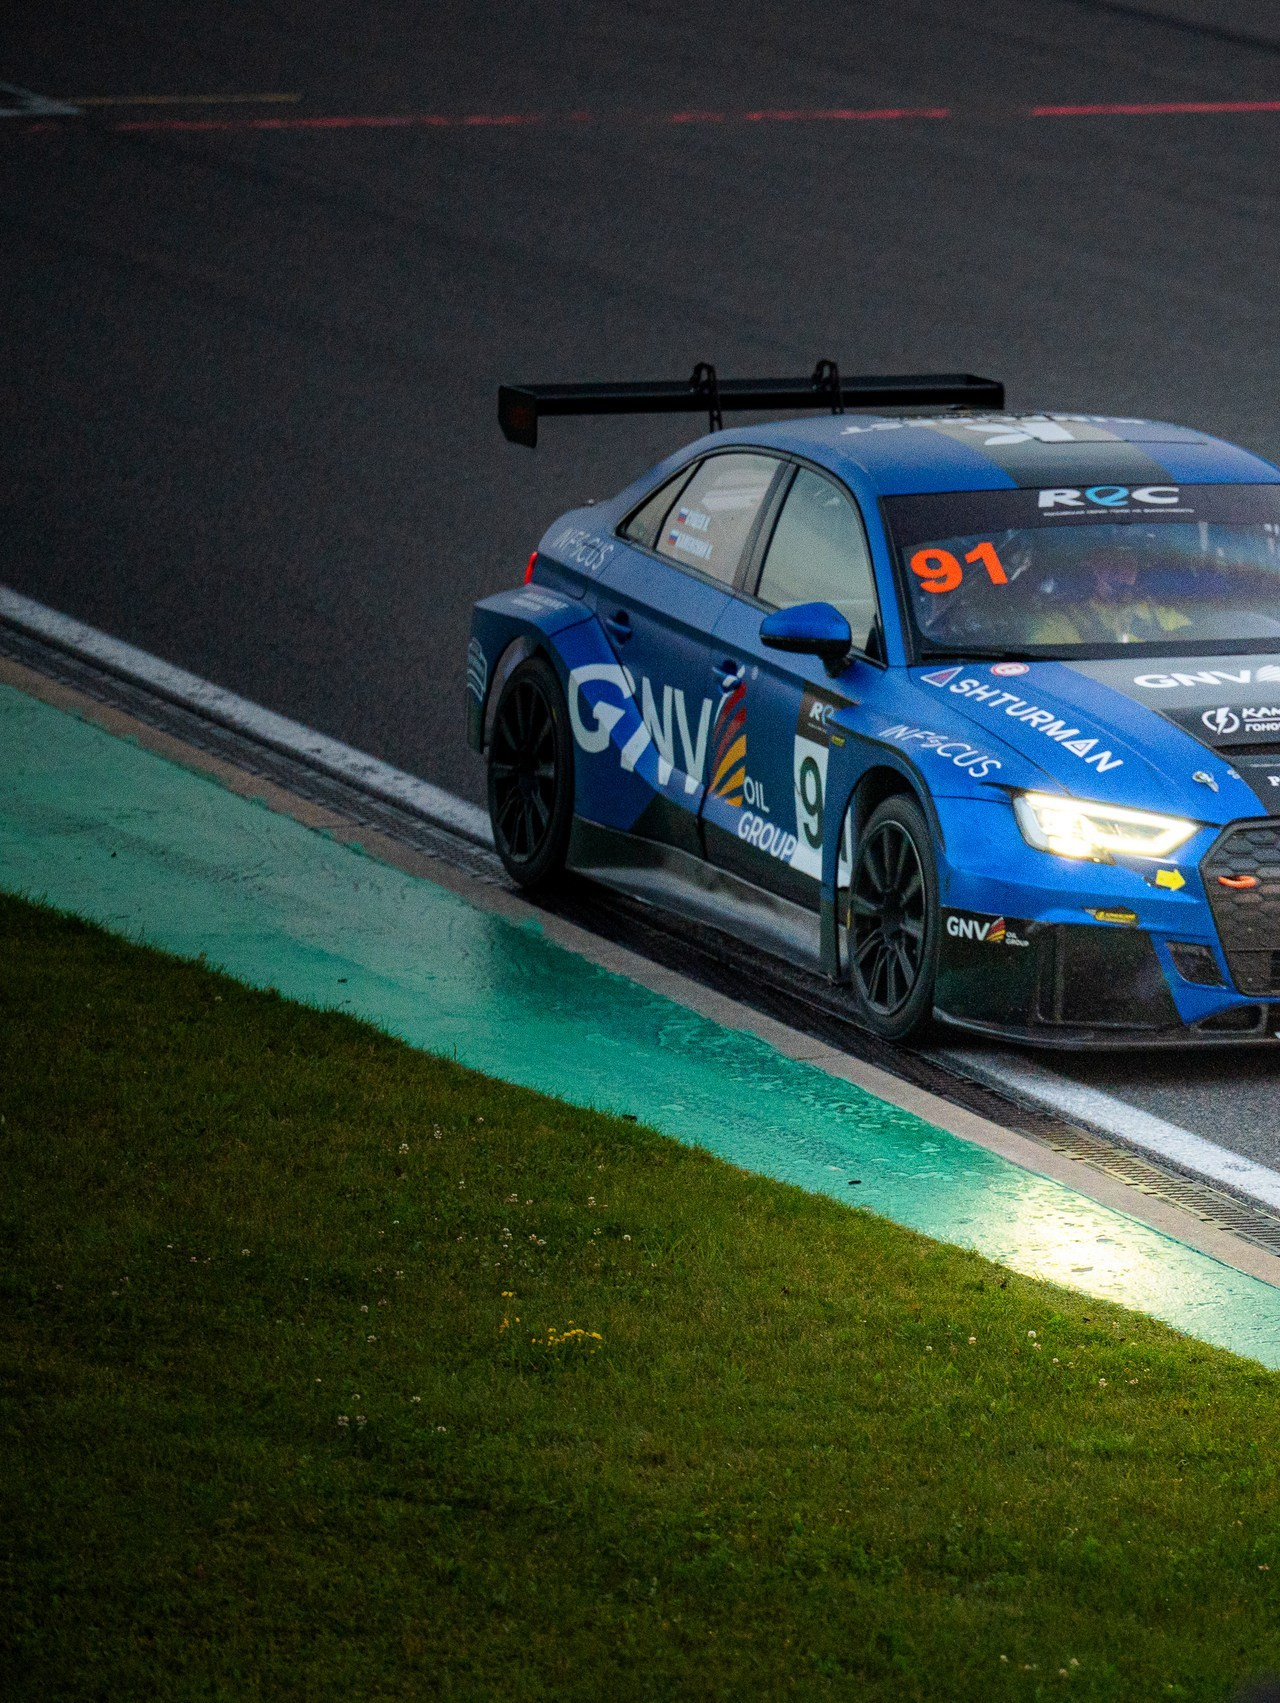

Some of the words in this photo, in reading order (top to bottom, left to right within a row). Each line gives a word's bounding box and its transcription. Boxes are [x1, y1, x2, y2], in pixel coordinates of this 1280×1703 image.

[910, 541, 1009, 593] 91
[1133, 669, 1251, 689] GNV
[568, 663, 713, 795] GNV
[949, 678, 1124, 773] SHTURMAN
[743, 775, 770, 814] OIL
[738, 810, 799, 863] GROUP
[946, 915, 990, 941] GNV
